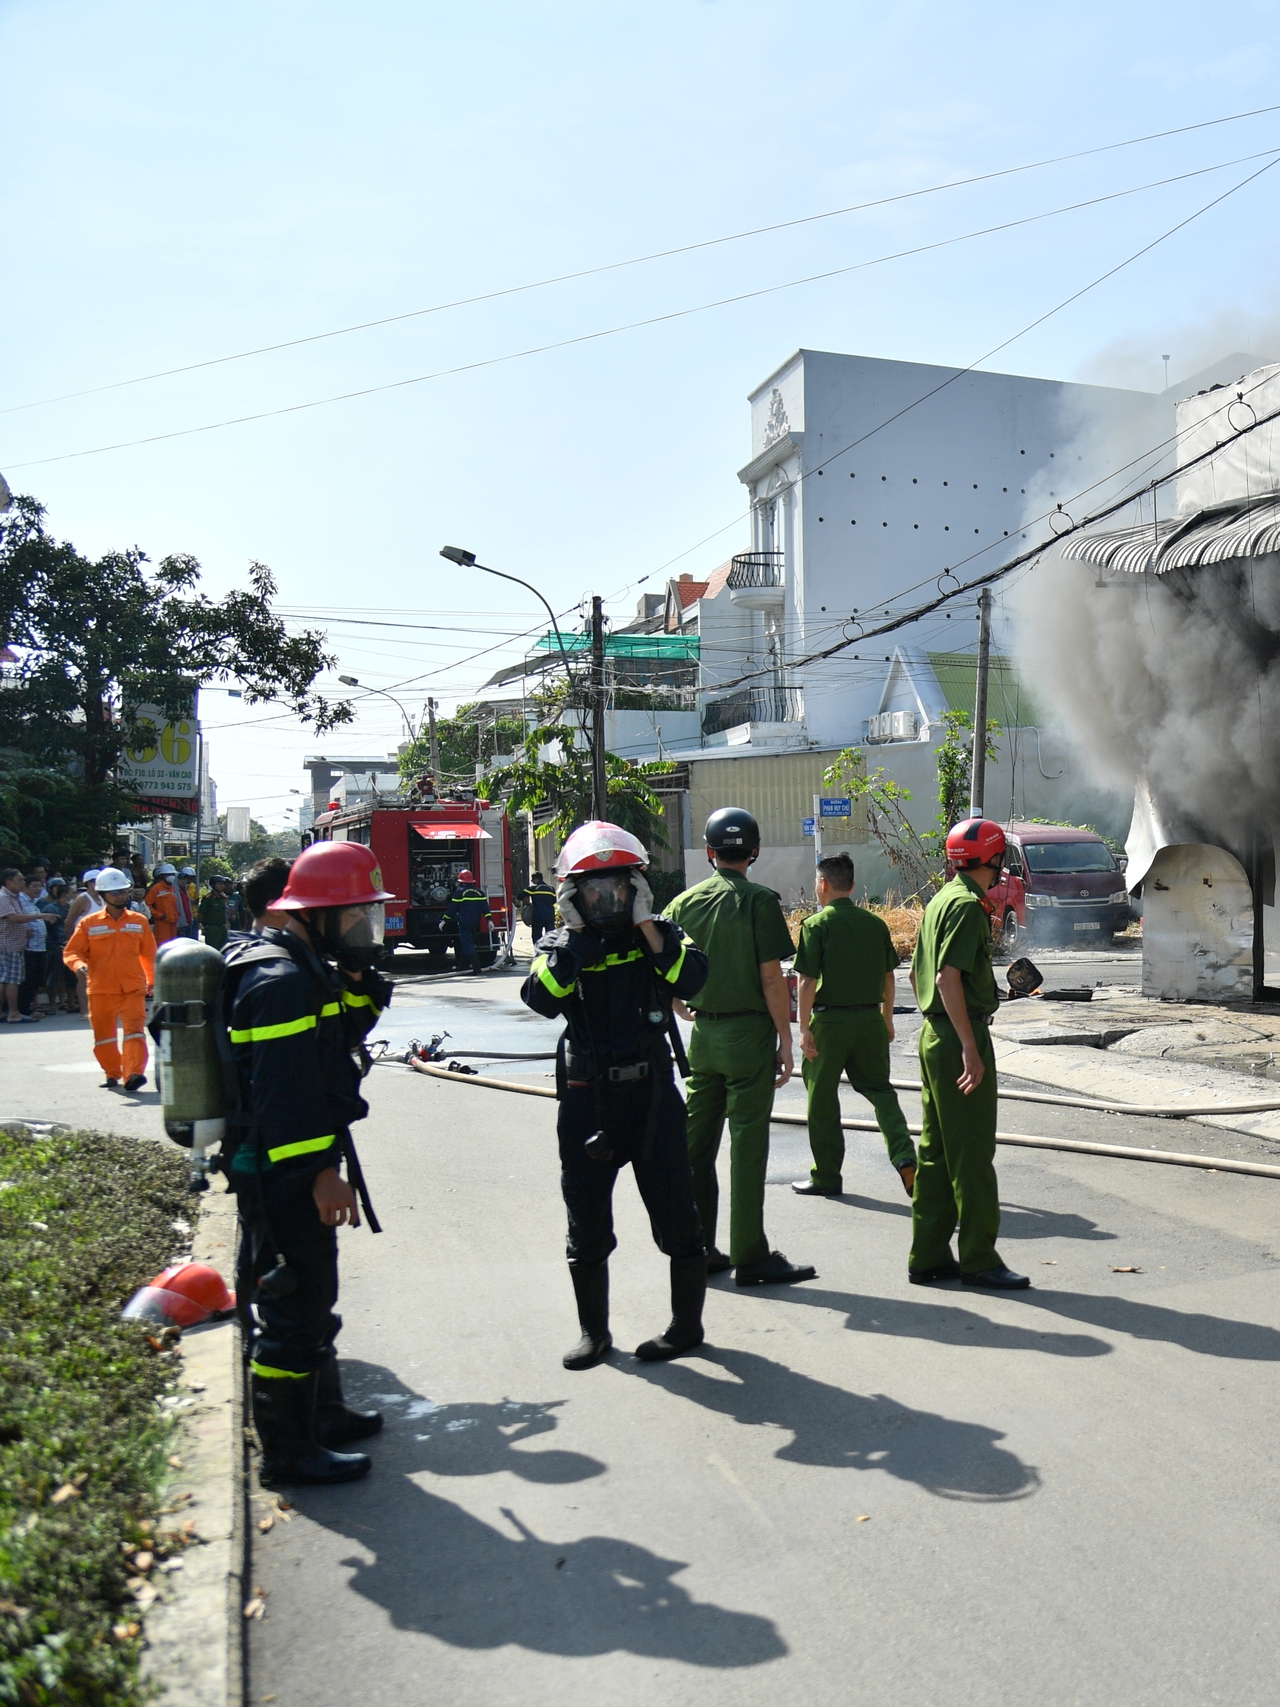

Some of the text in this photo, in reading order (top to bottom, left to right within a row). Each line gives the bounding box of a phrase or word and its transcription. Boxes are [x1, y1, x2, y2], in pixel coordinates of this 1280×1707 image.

[157, 769, 164, 778] 33
[161, 781, 175, 790] 943
[177, 782, 192, 791] 575
